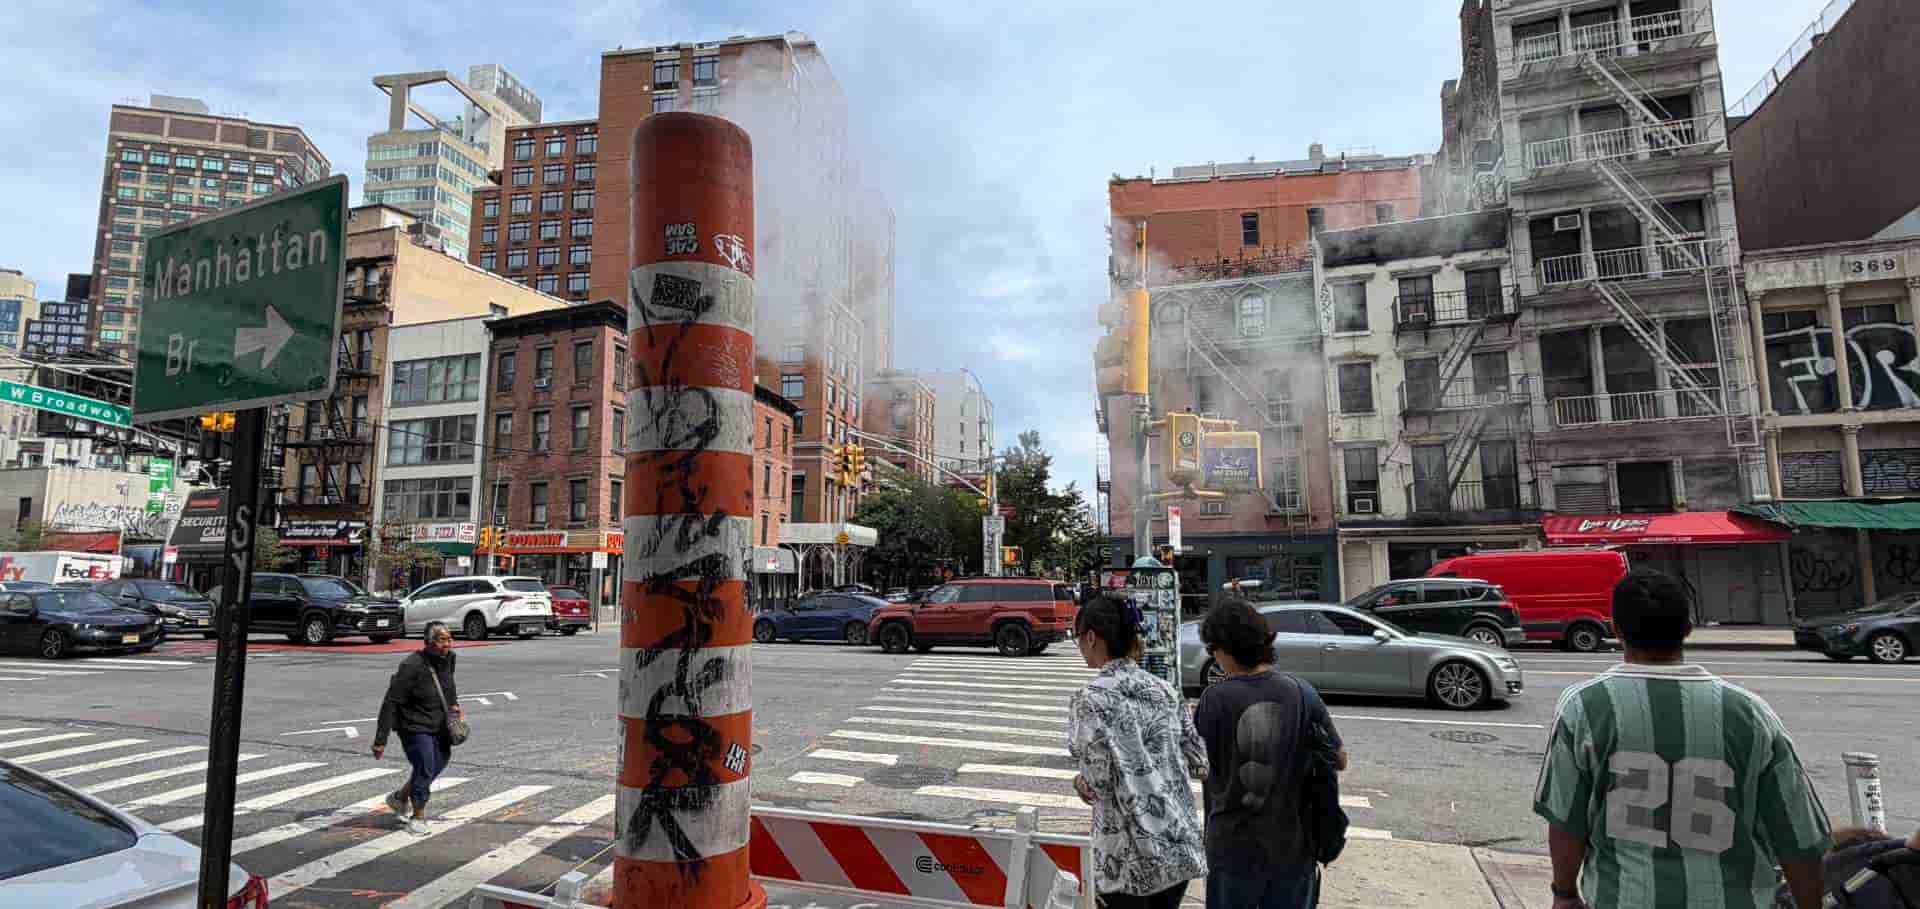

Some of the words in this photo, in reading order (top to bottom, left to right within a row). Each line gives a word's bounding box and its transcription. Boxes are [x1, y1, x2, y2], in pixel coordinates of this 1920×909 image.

[153, 226, 327, 300] Manhattan
[1852, 258, 1895, 272] 369
[165, 333, 199, 377] Br
[10, 387, 25, 399] W
[31, 391, 123, 423] Broadway
[62, 563, 113, 579] FedEx
[1605, 751, 1736, 853] 26
